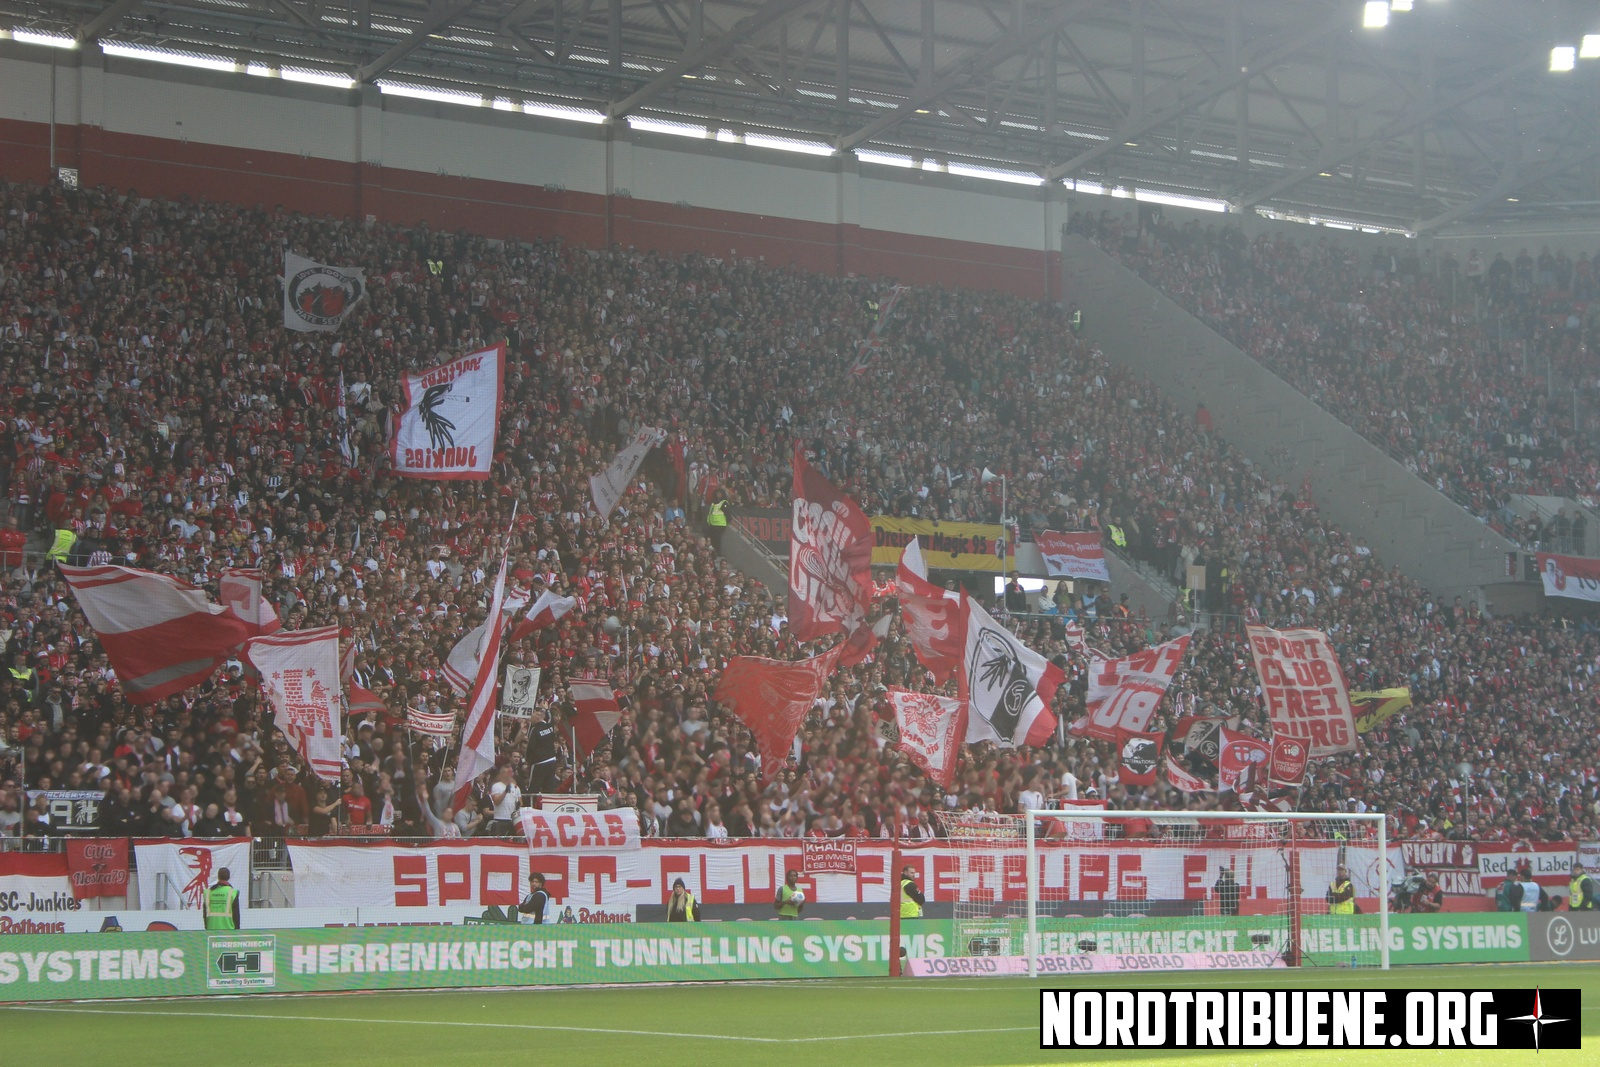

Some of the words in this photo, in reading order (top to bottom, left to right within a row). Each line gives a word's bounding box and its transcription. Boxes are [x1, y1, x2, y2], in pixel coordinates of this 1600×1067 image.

[972, 534, 987, 555] 95
[1252, 635, 1321, 660] SPORT
[1259, 657, 1333, 687] CLUB
[1266, 687, 1343, 719] FREI
[531, 814, 627, 848] ACAB
[806, 841, 853, 853] KHALID
[806, 852, 824, 861] FÜR
[825, 853, 853, 862] IMMER
[1402, 842, 1457, 866] FIGHT
[828, 861, 846, 869] UNS
[1482, 856, 1508, 874] Red
[1537, 855, 1575, 873] Label
[0, 889, 82, 912] SC-Junkies
[578, 907, 632, 924] Rothaus
[211, 940, 273, 949] HERRENKNECHT
[1412, 924, 1522, 951] SYSTEMS
[292, 939, 578, 975] HERRENKNECHT
[590, 935, 793, 968] TUNNELLING
[803, 933, 945, 963] SYSTMS
[1116, 953, 1185, 971] JOBRAD
[1208, 951, 1273, 969] JOBRAD
[0, 947, 186, 985] SYSTEMS
[924, 956, 997, 975] JOBRAD
